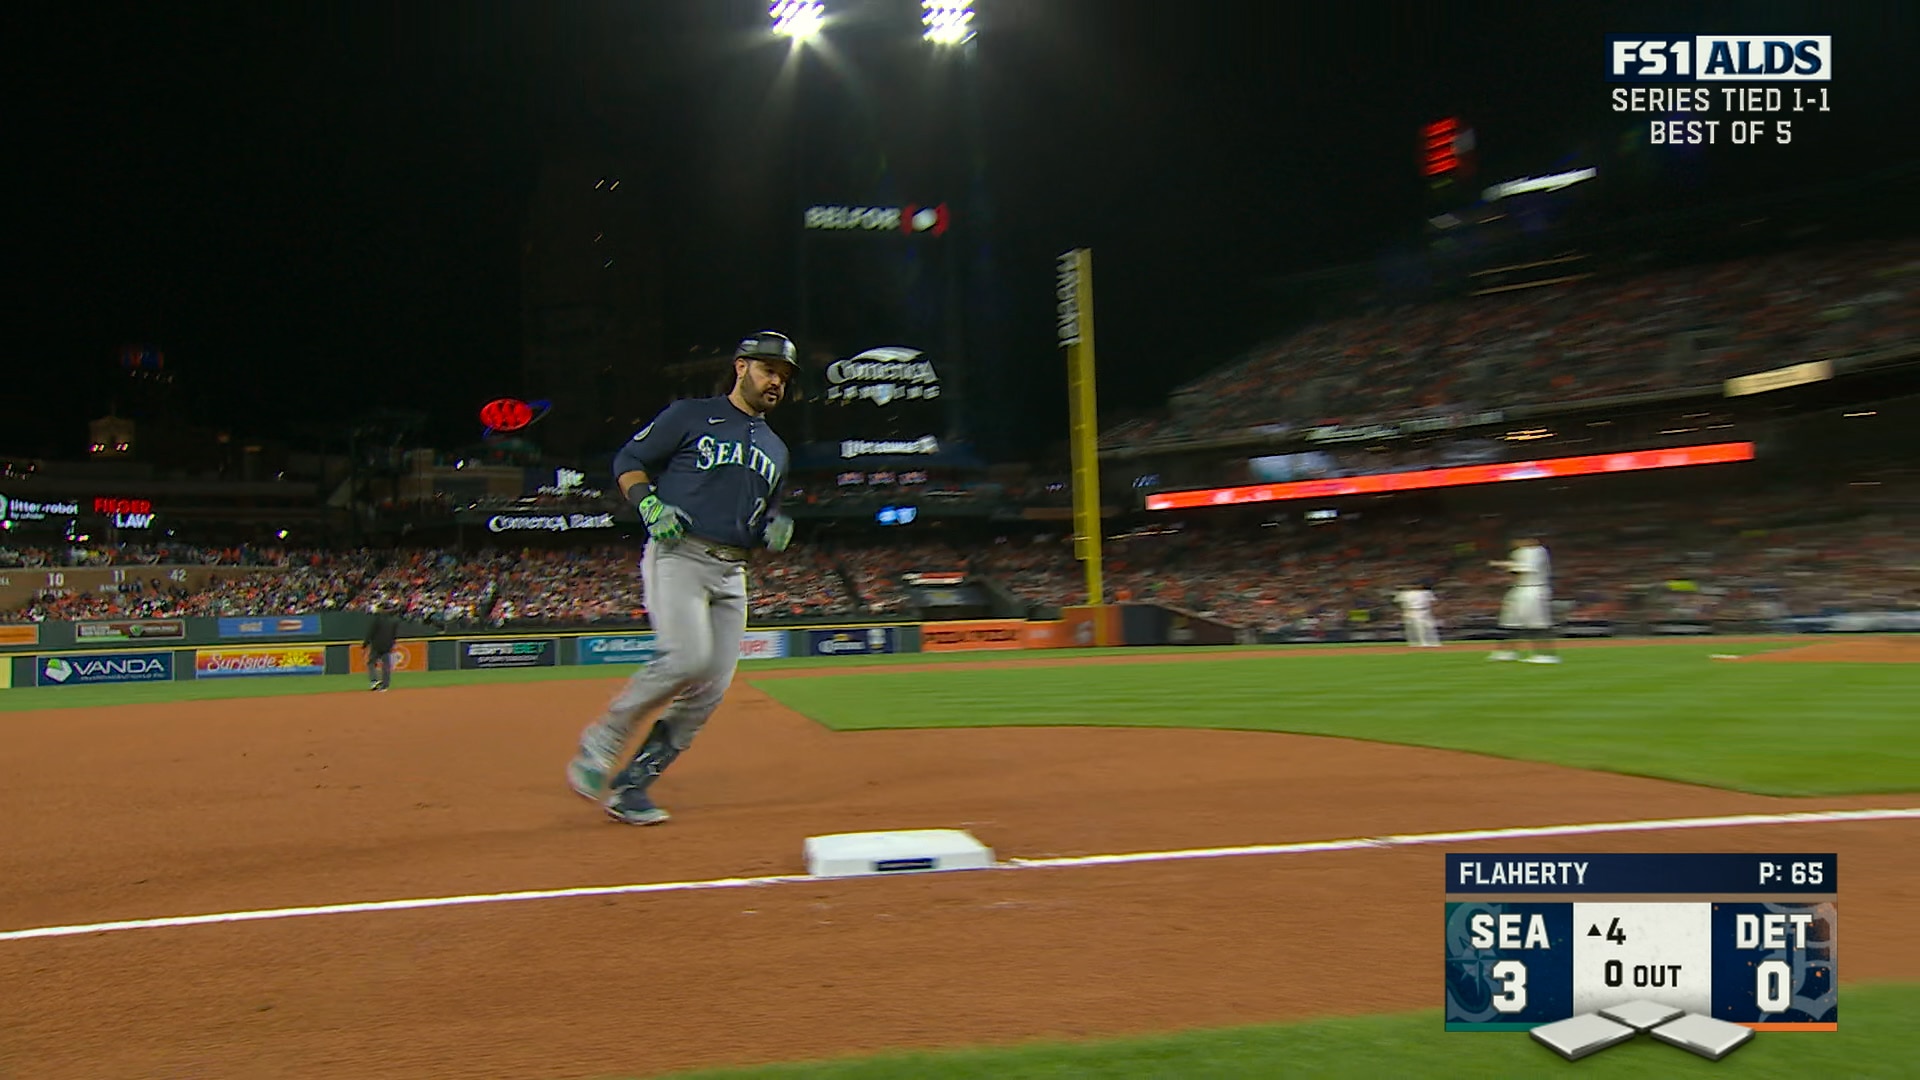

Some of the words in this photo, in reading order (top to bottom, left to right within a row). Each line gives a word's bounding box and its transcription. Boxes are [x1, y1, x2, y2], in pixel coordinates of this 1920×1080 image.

[115, 513, 151, 528] LAW
[169, 569, 187, 582] 42
[73, 659, 165, 675] VANDA
[207, 653, 277, 672] Surfside
